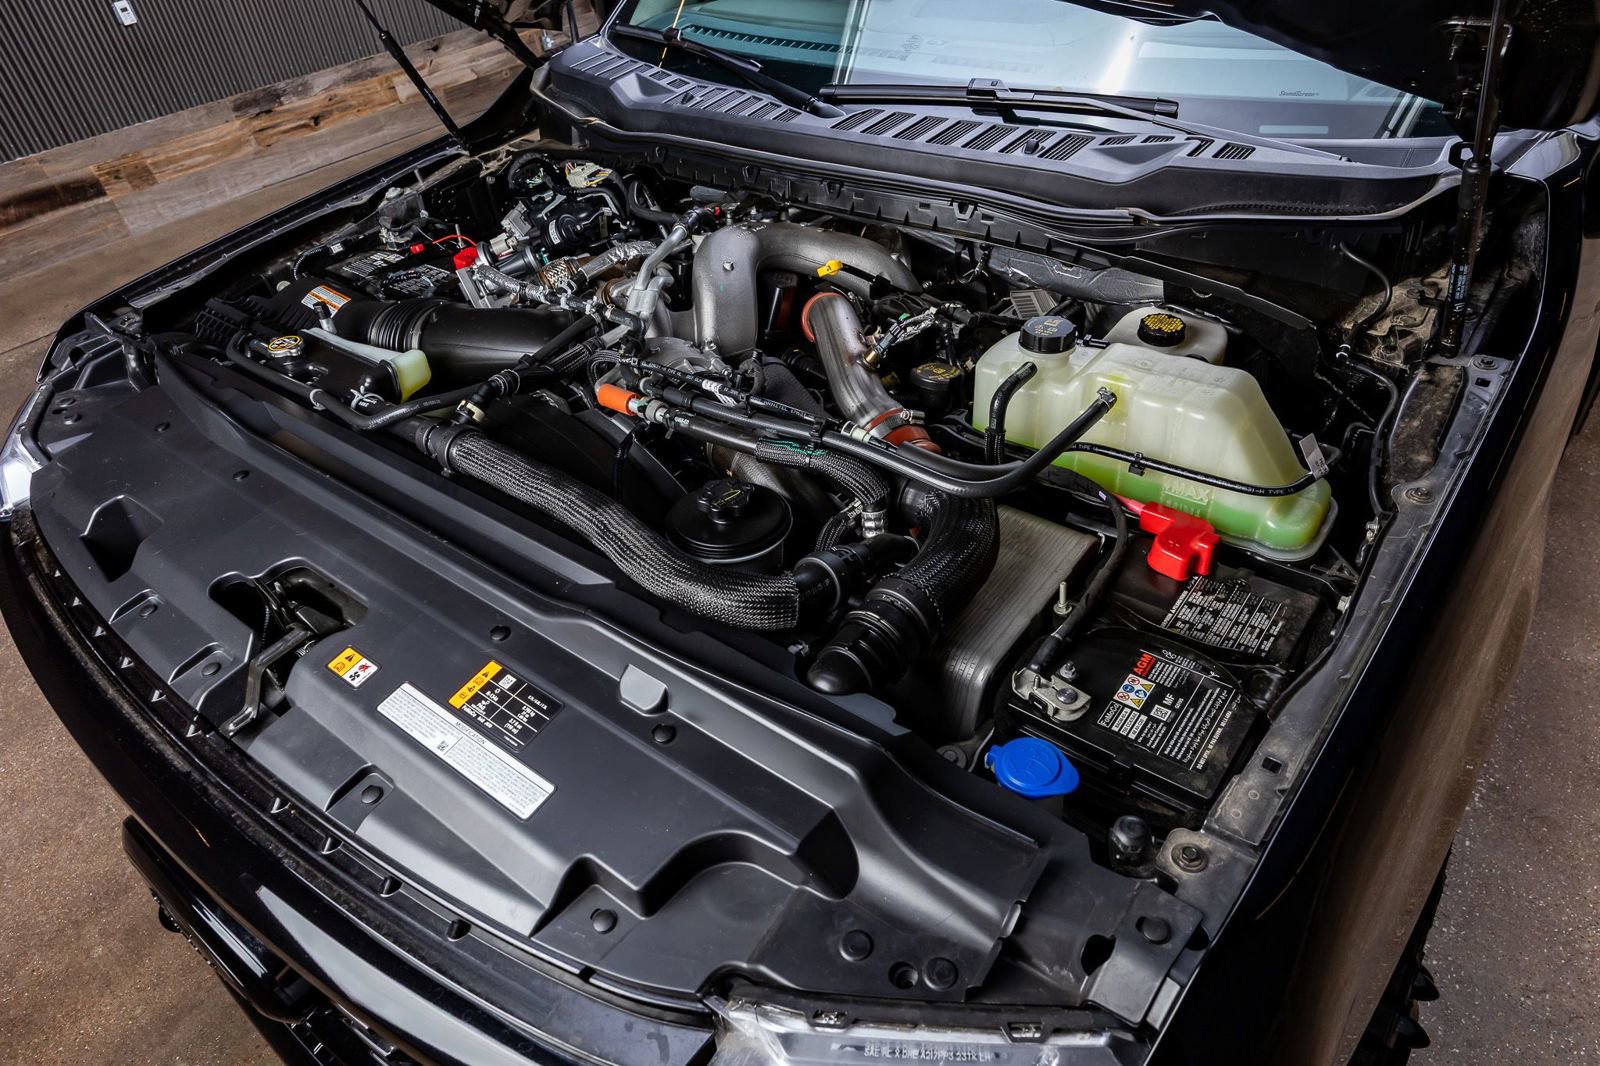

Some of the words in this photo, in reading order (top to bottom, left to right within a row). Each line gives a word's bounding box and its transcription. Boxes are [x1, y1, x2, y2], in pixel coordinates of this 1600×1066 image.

[1133, 653, 1153, 675] AGM
[1163, 693, 1175, 706] MF
[1101, 703, 1120, 726] FoMoCo
[456, 721, 486, 745] MODIFICATION
[863, 1046, 880, 1057] SAE
